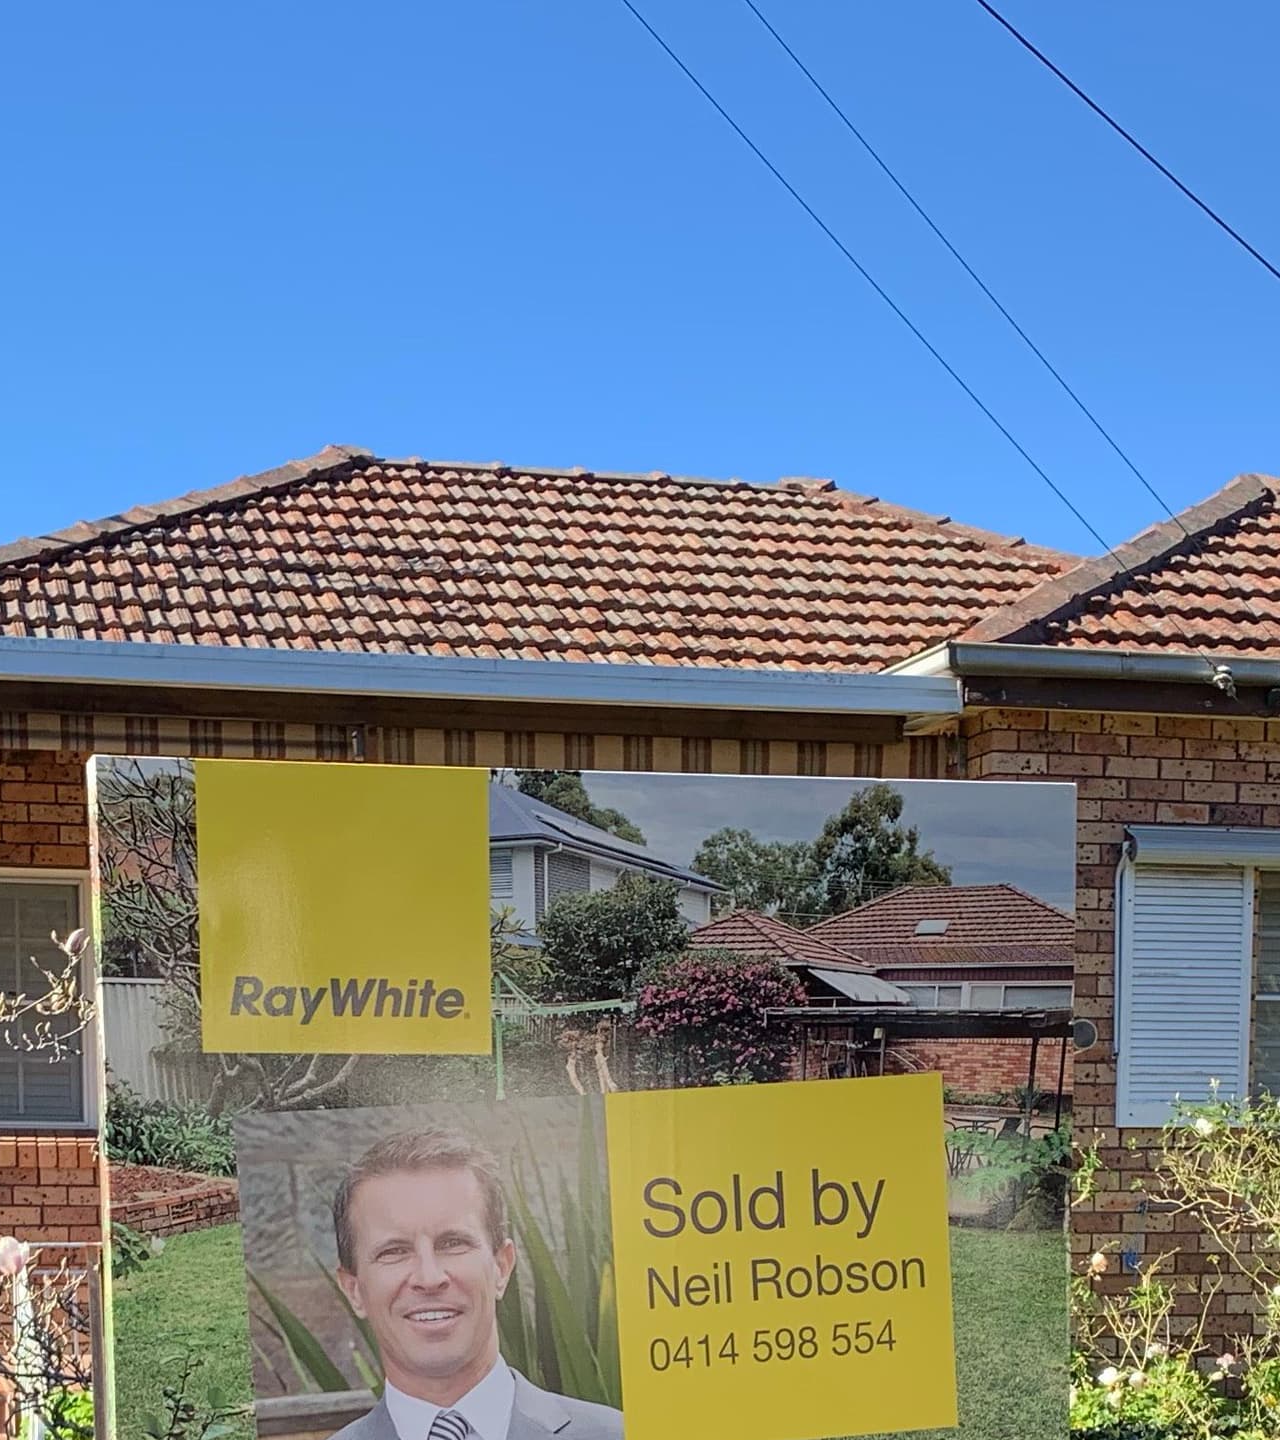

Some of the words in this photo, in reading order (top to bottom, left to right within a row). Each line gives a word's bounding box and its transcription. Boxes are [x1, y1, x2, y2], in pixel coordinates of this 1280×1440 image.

[643, 1171, 785, 1238] Sold
[812, 1168, 885, 1239] by
[648, 1261, 732, 1309] Neil
[751, 1254, 925, 1301] Robson
[650, 1332, 739, 1371] 0414
[753, 1326, 818, 1362] 598
[832, 1319, 896, 1356] 554
